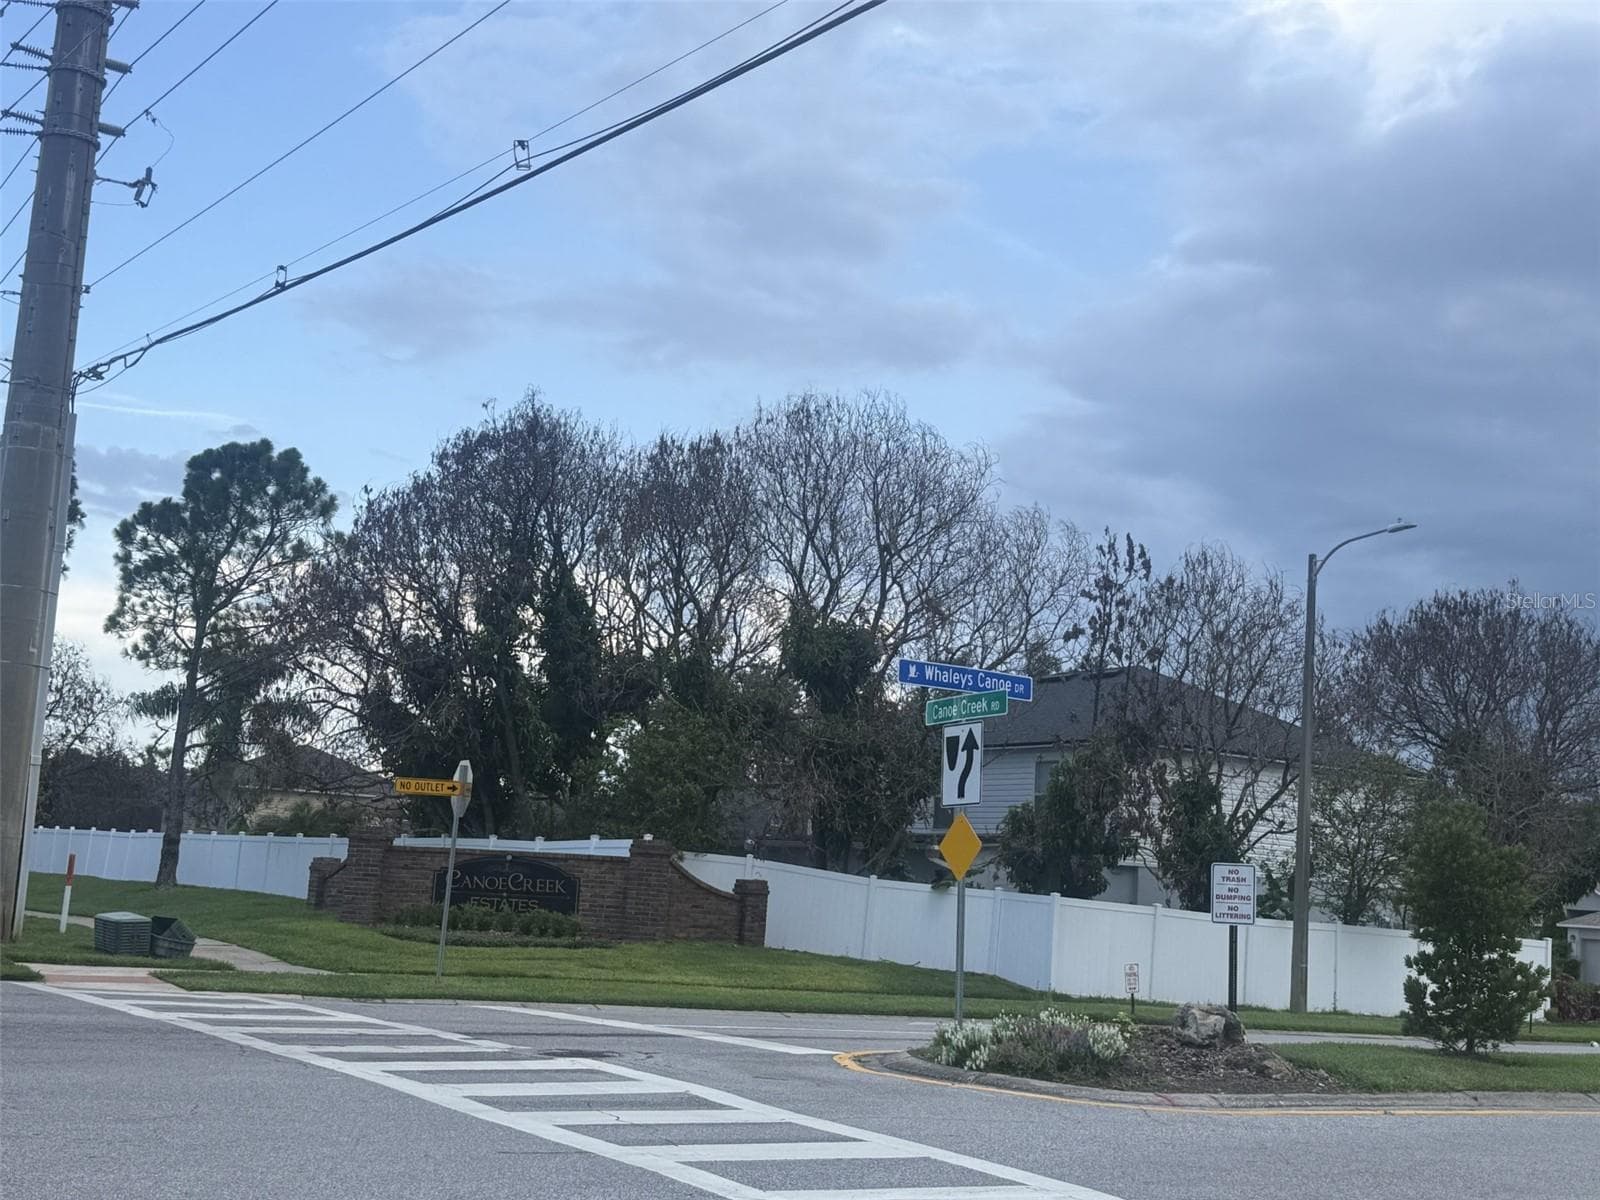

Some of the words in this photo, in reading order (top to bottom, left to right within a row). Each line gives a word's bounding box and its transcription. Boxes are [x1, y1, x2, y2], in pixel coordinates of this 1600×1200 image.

[924, 664, 973, 689] Whaleys
[977, 672, 1012, 692] Canoe
[1014, 683, 1025, 694] DR
[932, 704, 958, 719] Canoe
[960, 698, 988, 714] Creek
[400, 781, 411, 790] NO
[414, 782, 444, 792] OUTLET
